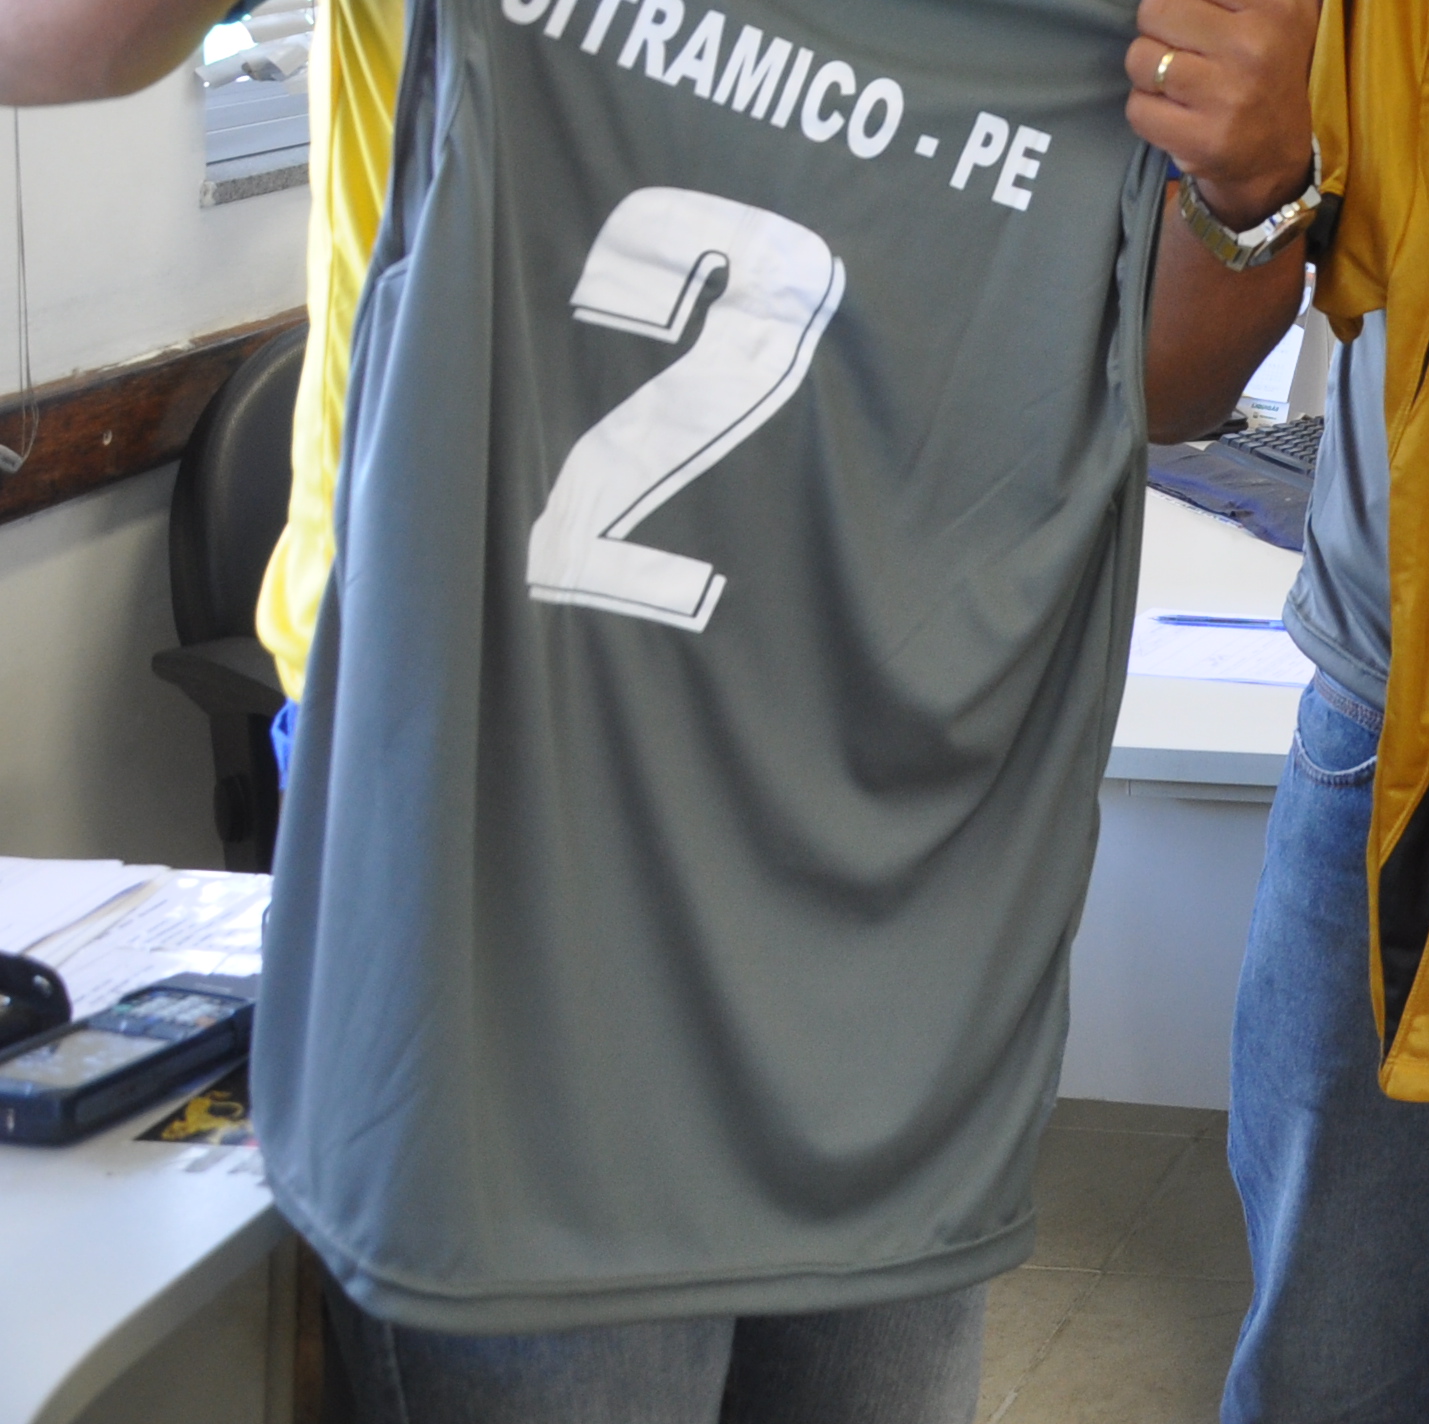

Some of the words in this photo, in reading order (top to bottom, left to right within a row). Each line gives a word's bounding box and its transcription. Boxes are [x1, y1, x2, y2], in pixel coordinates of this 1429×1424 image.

[914, 134, 939, 158] -
[949, 111, 1052, 212] PE
[526, 186, 847, 633] 2
